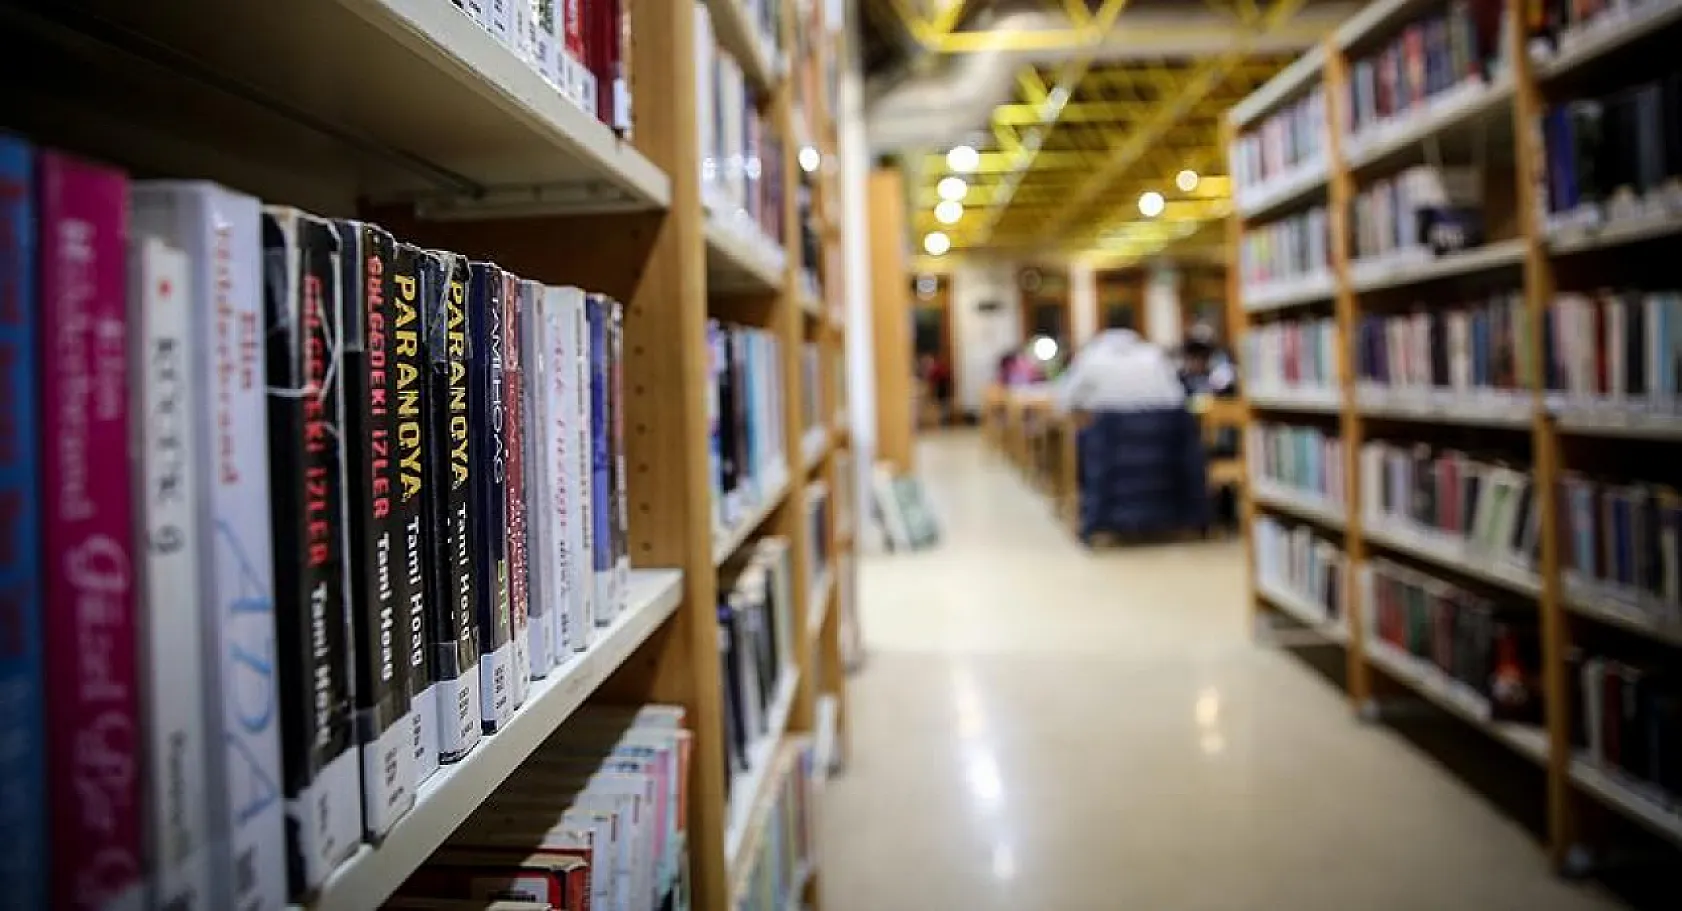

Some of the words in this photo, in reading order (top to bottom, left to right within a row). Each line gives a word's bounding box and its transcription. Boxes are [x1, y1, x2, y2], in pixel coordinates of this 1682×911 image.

[492, 297, 502, 369] TAMI
[394, 275, 421, 497] PARANOYA
[448, 281, 469, 487] PARANOYA
[377, 532, 393, 601] Tami
[407, 515, 422, 585] Tami
[457, 501, 469, 566] Tami
[311, 580, 329, 657] Tami
[380, 606, 394, 681] Hoag
[410, 592, 424, 667] Hoag
[460, 573, 470, 641] Hoag
[213, 518, 278, 824] ADA
[314, 663, 332, 748] Hoag
